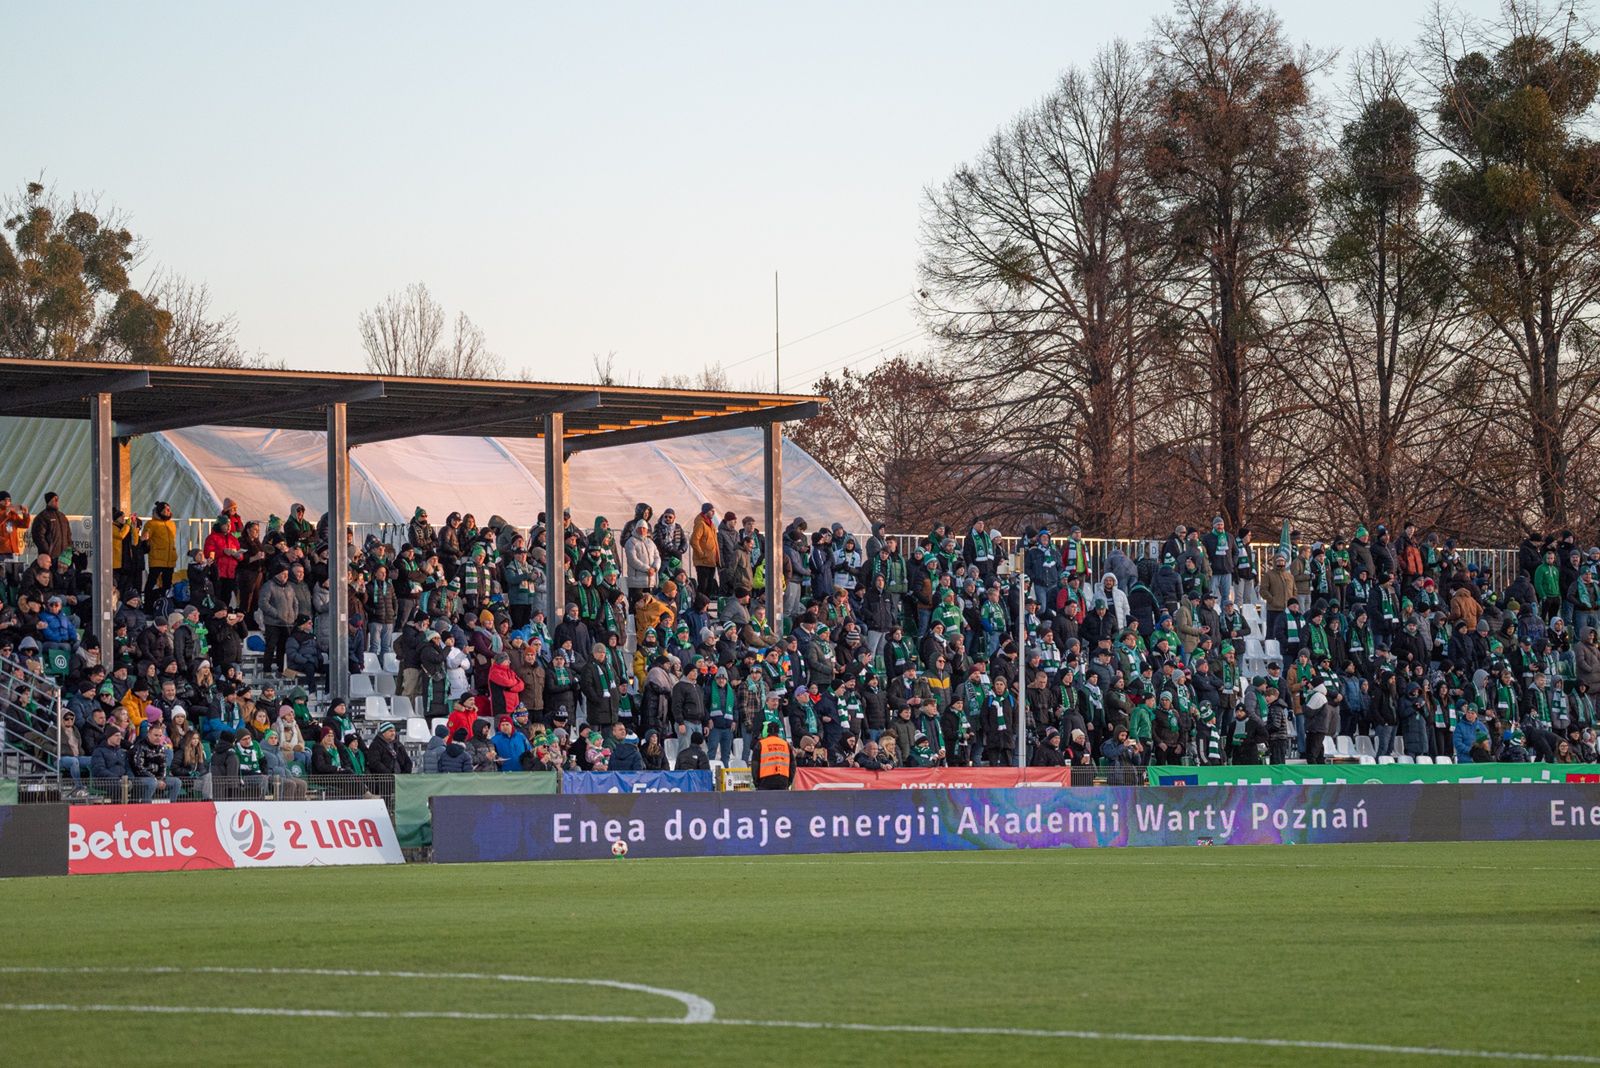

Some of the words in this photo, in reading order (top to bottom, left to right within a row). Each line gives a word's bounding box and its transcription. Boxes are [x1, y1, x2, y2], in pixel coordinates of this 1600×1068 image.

[68, 817, 197, 860] Betclic
[284, 820, 307, 849] 2
[311, 818, 382, 849] LIGA
[553, 813, 645, 843] Enea
[664, 808, 792, 847] dodaje
[809, 806, 940, 844] energii
[957, 803, 1119, 835] Akademii
[1135, 803, 1236, 838] Warty
[1252, 799, 1368, 830] Poznań
